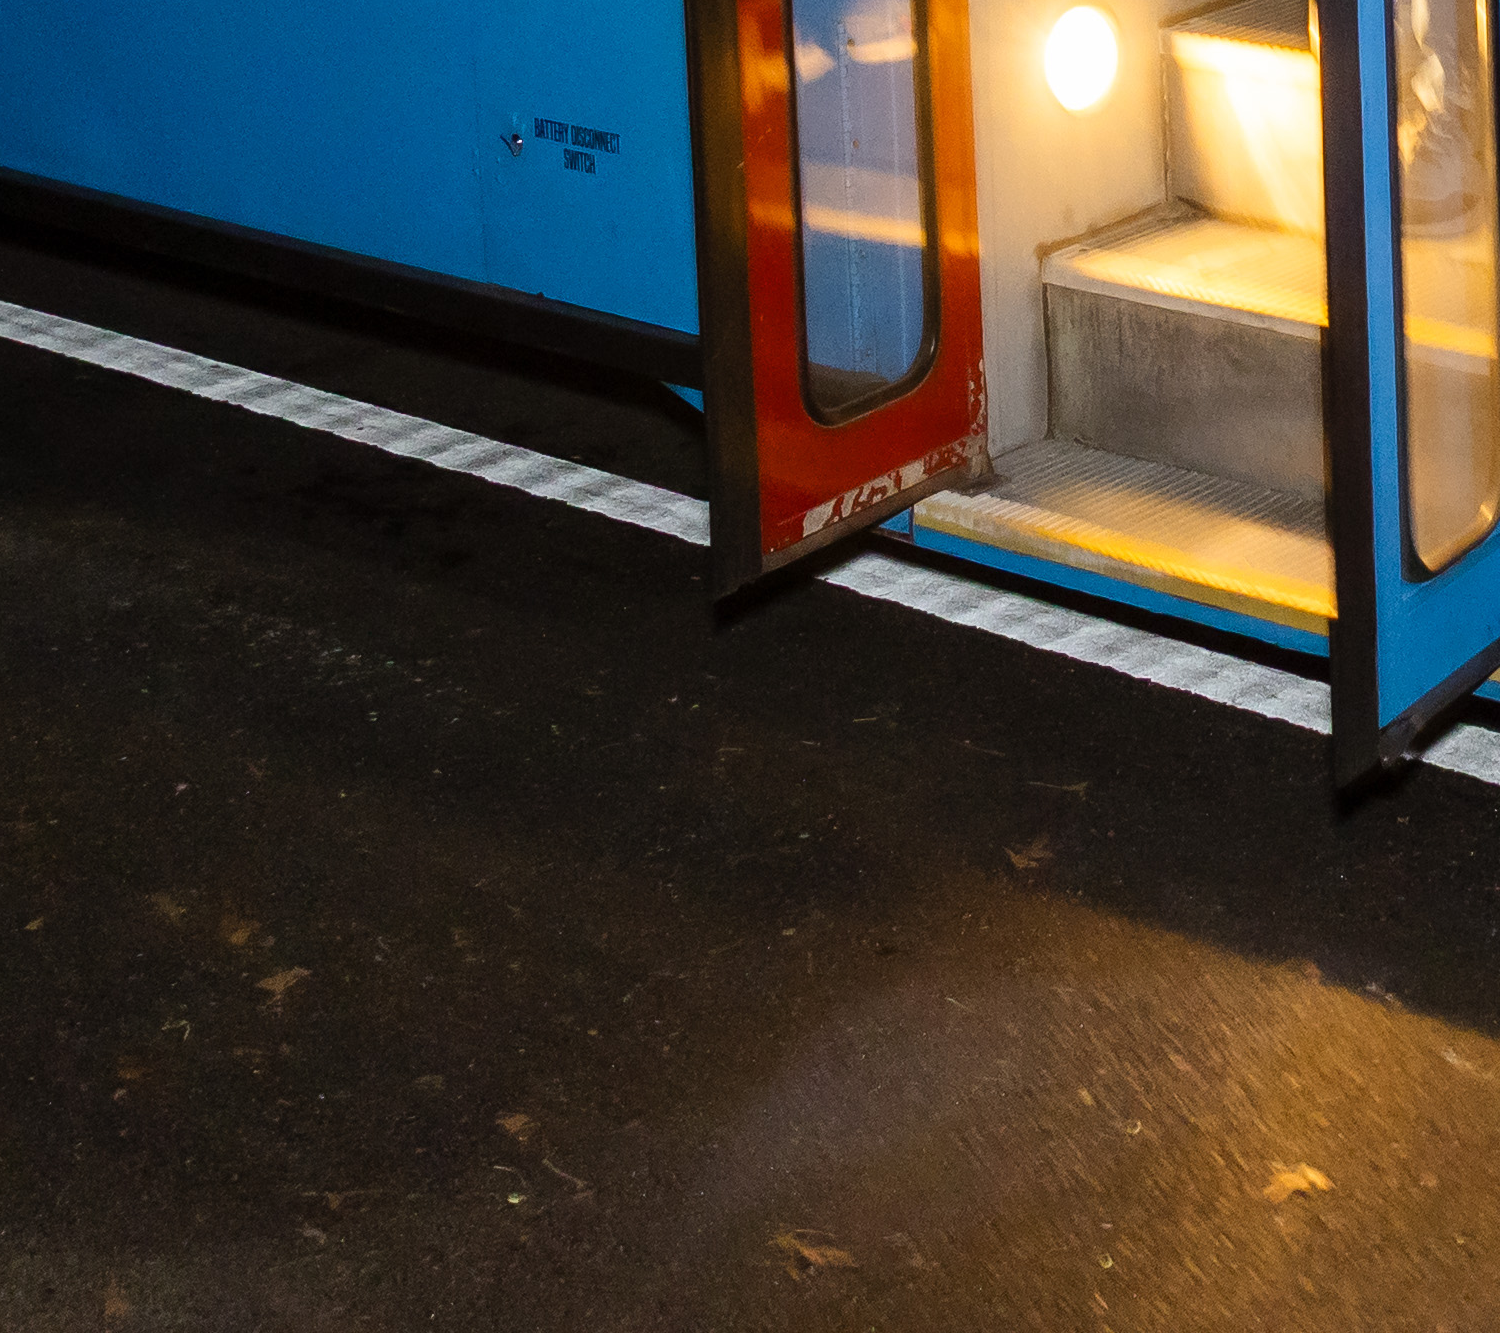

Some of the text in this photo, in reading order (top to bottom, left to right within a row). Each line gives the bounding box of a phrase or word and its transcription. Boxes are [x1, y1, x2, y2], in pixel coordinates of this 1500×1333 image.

[534, 117, 621, 155] BATTERY DISCONNECT
[563, 147, 597, 175] SWITCH
